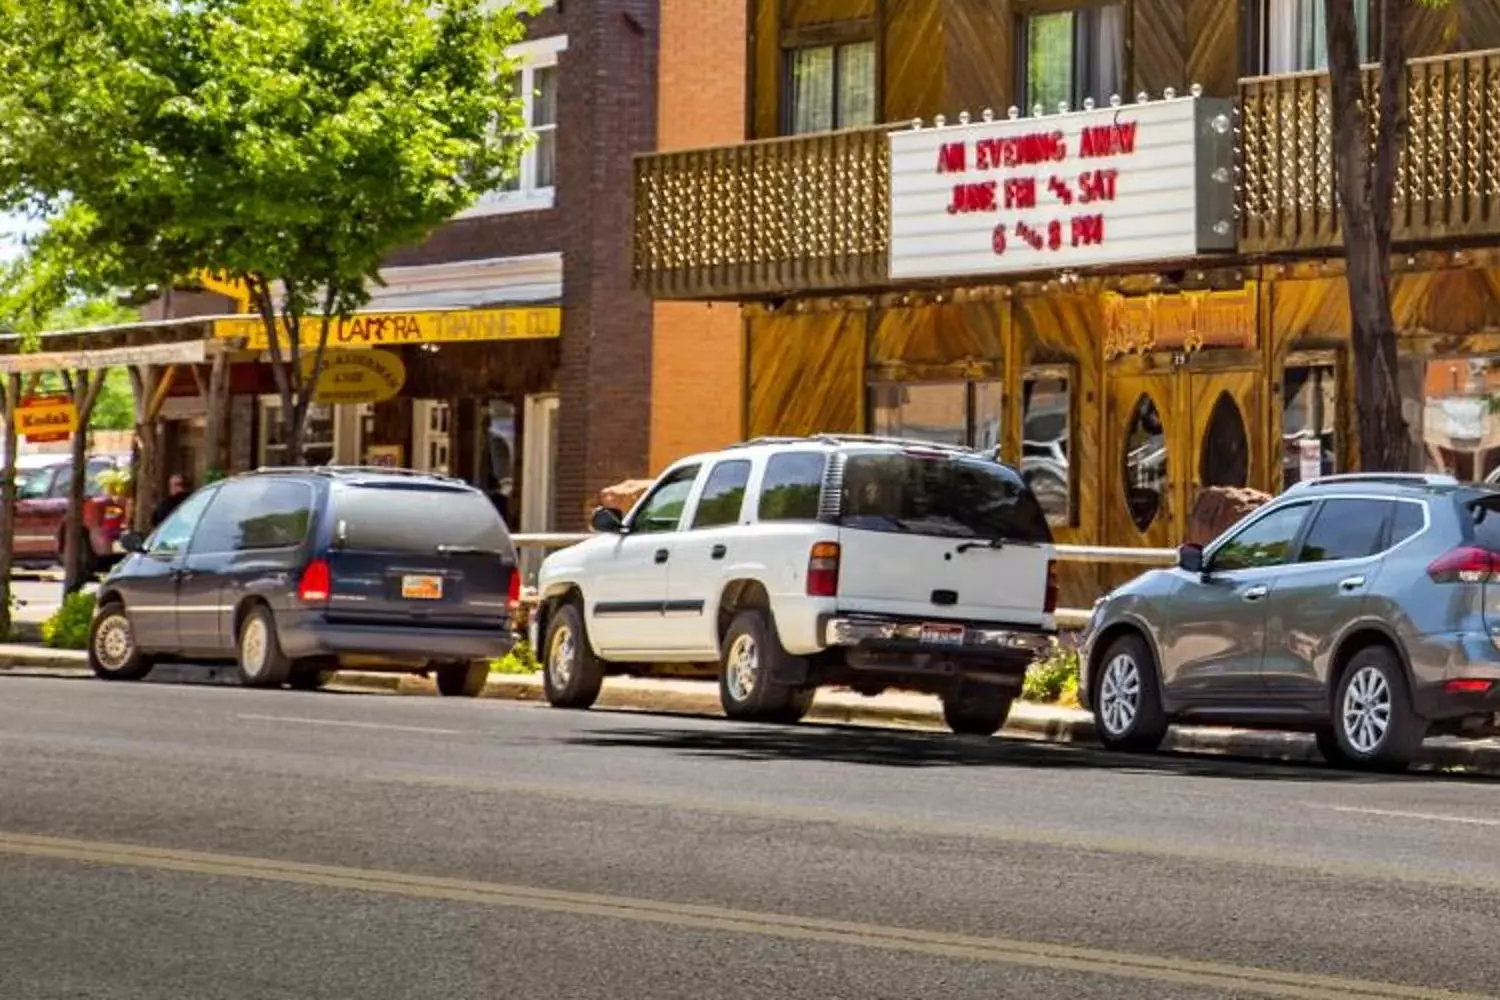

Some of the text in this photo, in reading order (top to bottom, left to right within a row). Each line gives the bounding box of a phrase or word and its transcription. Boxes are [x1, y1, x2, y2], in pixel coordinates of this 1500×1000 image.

[936, 121, 1137, 174] AN EVENING AWAY
[948, 180, 997, 214] JUNE
[1004, 177, 1036, 209] FRI
[1078, 169, 1119, 203] SAT
[1071, 213, 1104, 247] PM
